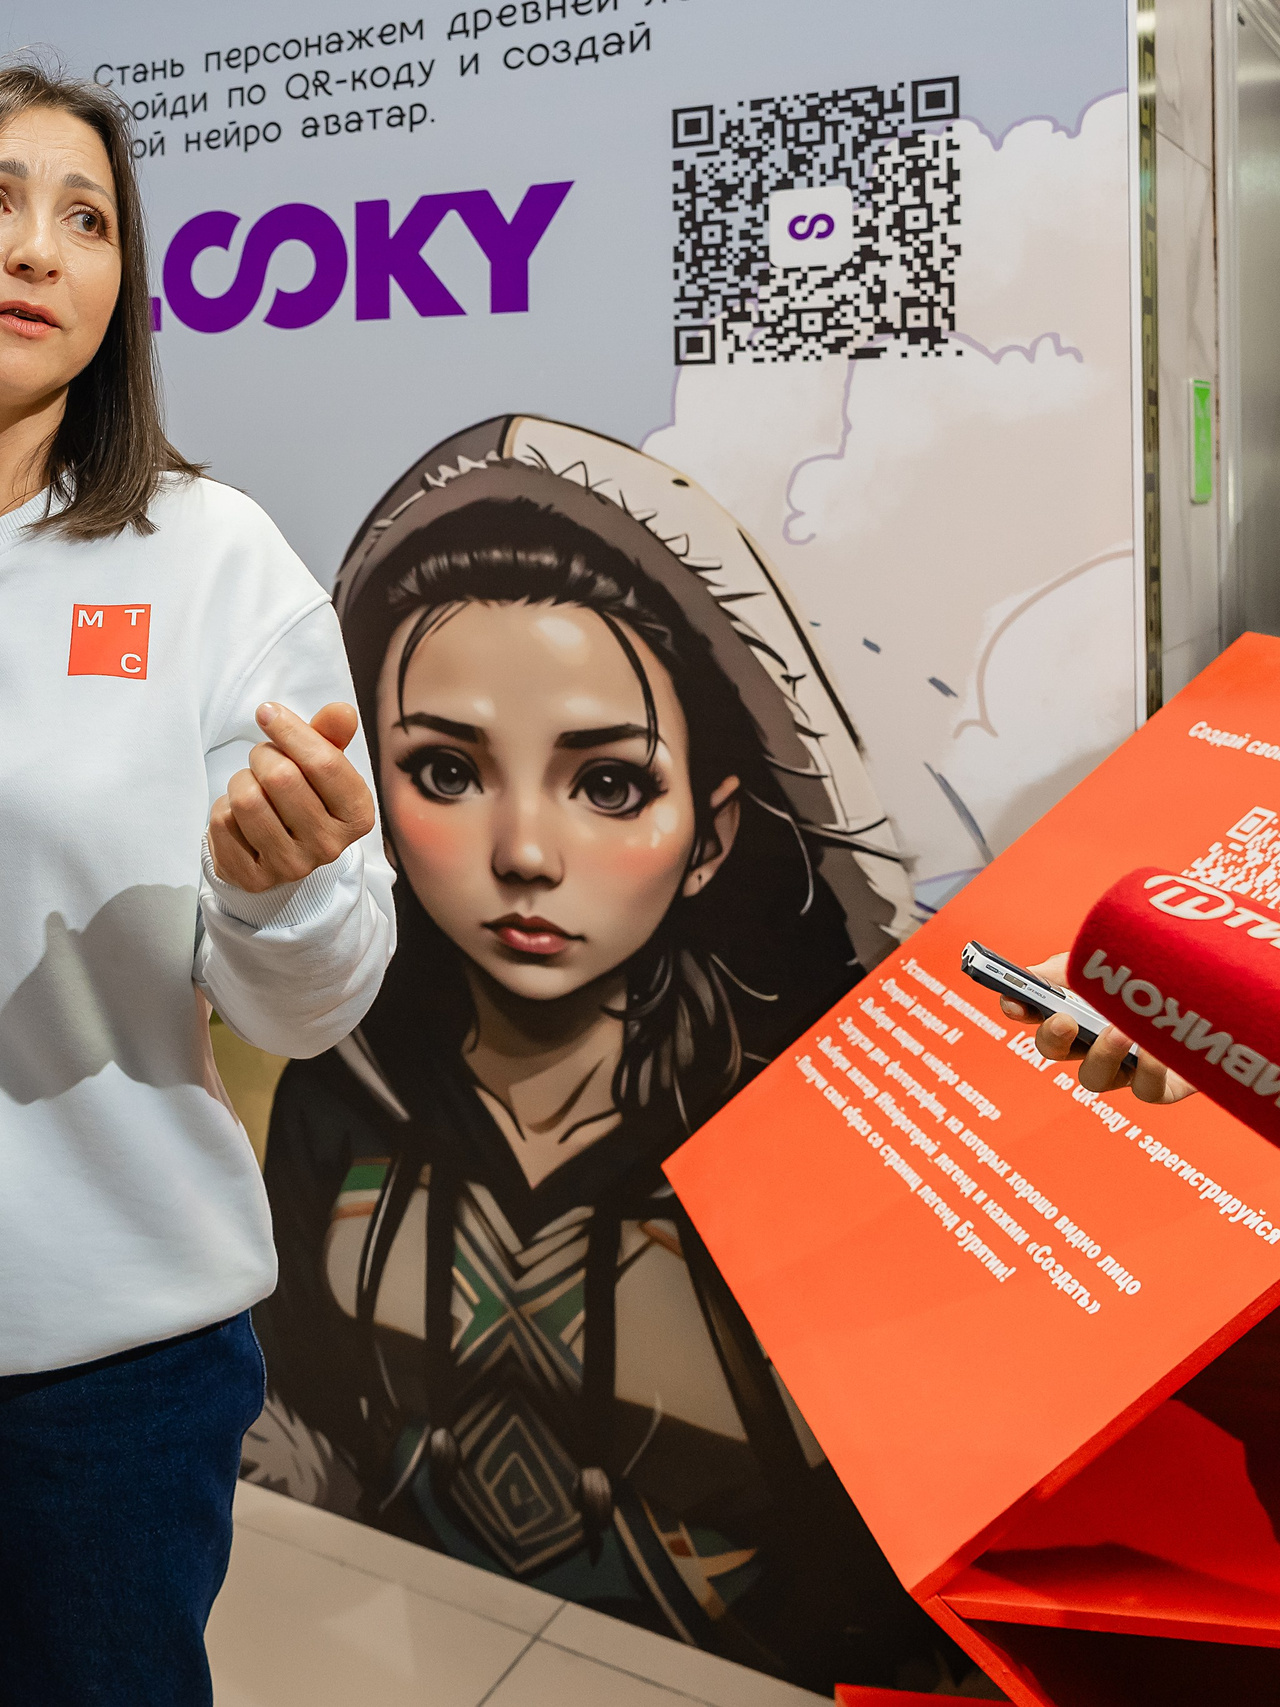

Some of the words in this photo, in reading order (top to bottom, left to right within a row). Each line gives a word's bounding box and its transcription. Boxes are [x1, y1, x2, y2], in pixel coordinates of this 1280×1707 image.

[94, 58, 185, 88] Стань
[205, 18, 424, 74] персонажем
[227, 84, 266, 108] по
[285, 58, 435, 100] QR-коду
[460, 53, 480, 77] и
[503, 21, 651, 70] создай
[185, 120, 282, 153] нейро
[301, 102, 435, 139] аватар.
[151, 180, 575, 334] OOKY
[1188, 720, 1251, 750] Создай
[860, 998, 896, 1032] Выбери
[891, 1026, 925, 1056] опцию
[921, 1051, 960, 1086] «нейро
[954, 1080, 1001, 1121] аватар»
[881, 977, 918, 1010] Открой
[907, 1003, 949, 1036] раздел
[942, 1027, 964, 1045] AI
[839, 1016, 875, 1053] Загрузи
[867, 1047, 890, 1067] две
[884, 1060, 948, 1124] фотографии,
[944, 1115, 964, 1135] на
[959, 1128, 1011, 1177] которых
[1006, 1171, 1059, 1220] хорошо
[1054, 1215, 1102, 1260] видно
[1096, 1255, 1142, 1296] лицо
[902, 957, 947, 996] Установи
[942, 989, 1008, 1041] приложение
[1053, 1072, 1075, 1091] по
[1125, 1125, 1142, 1141] и
[1138, 1134, 1280, 1245] зарегистрируйся
[817, 1035, 852, 1073] Выбери
[846, 1066, 879, 1100] аватар
[972, 1189, 988, 1205] и
[981, 1199, 1030, 1246] нажми
[1025, 1241, 1101, 1315] «Создать»
[823, 1085, 849, 1111] свой
[842, 1105, 872, 1137] образ
[867, 1131, 884, 1149] со
[879, 1144, 923, 1193] страниц
[916, 1184, 961, 1232] легенд
[954, 1219, 1017, 1283] Бурятии!
